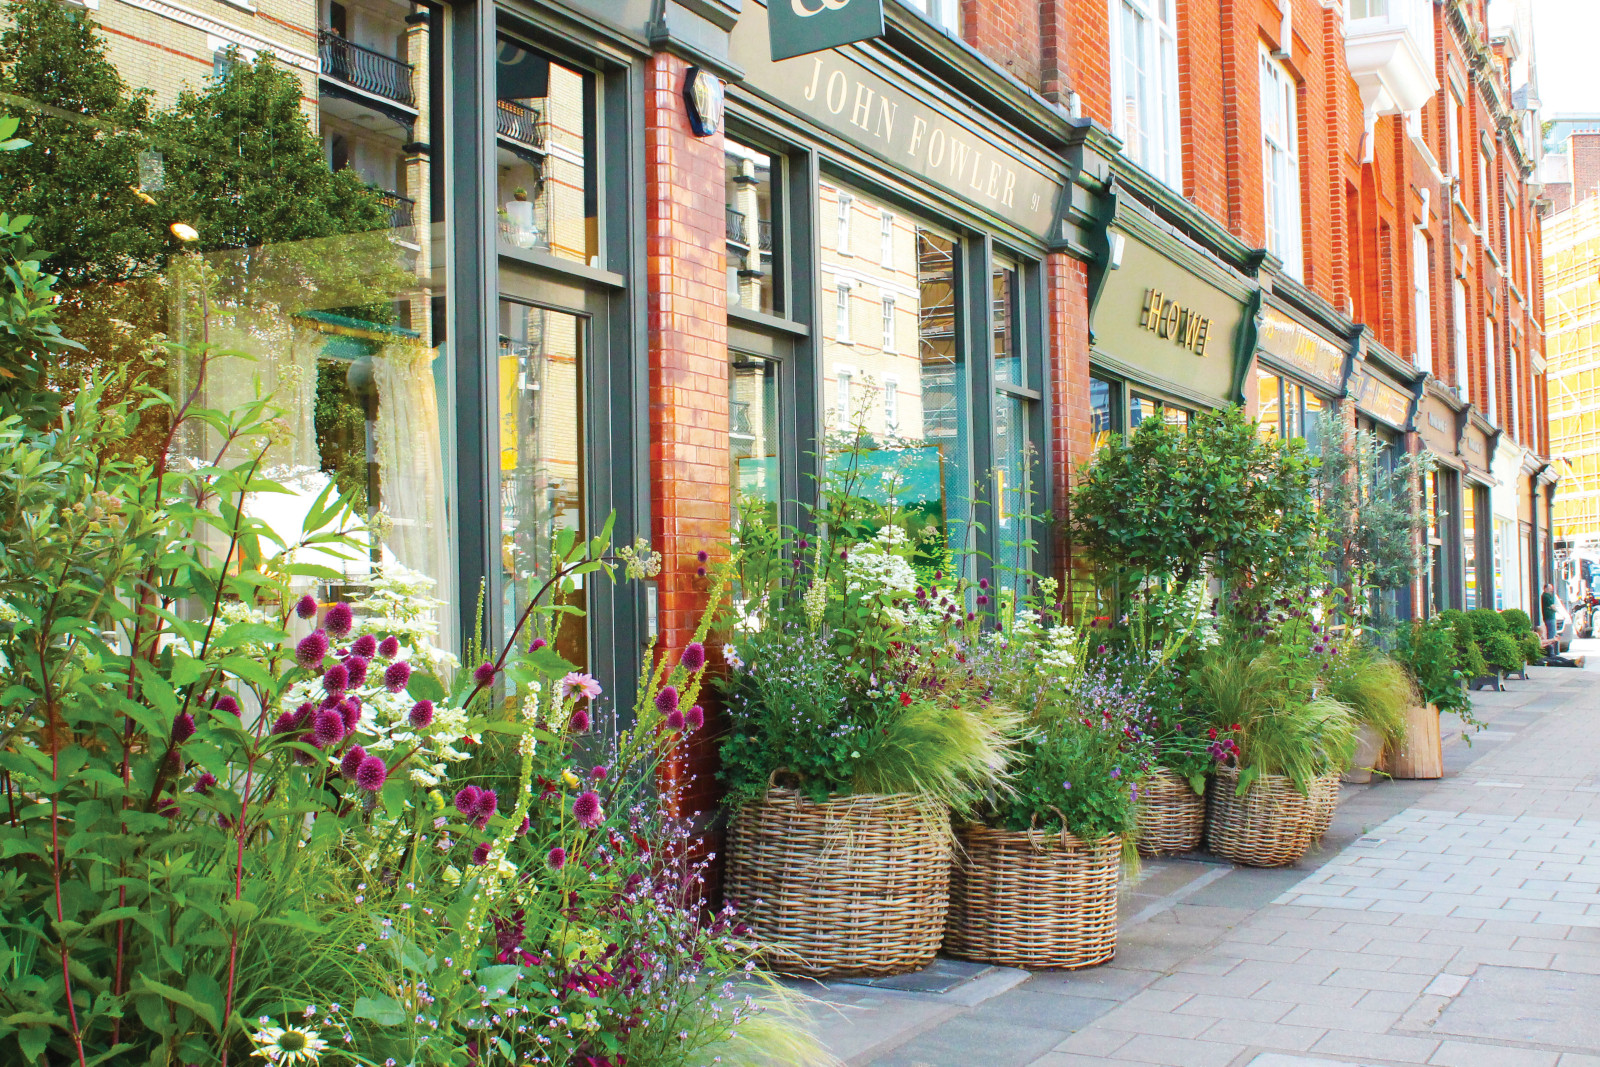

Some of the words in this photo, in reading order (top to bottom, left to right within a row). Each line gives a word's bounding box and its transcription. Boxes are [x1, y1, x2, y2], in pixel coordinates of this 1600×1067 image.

[804, 57, 898, 143] JOHN
[907, 115, 1017, 208] FOWLER
[1147, 288, 1214, 357] HOWE
